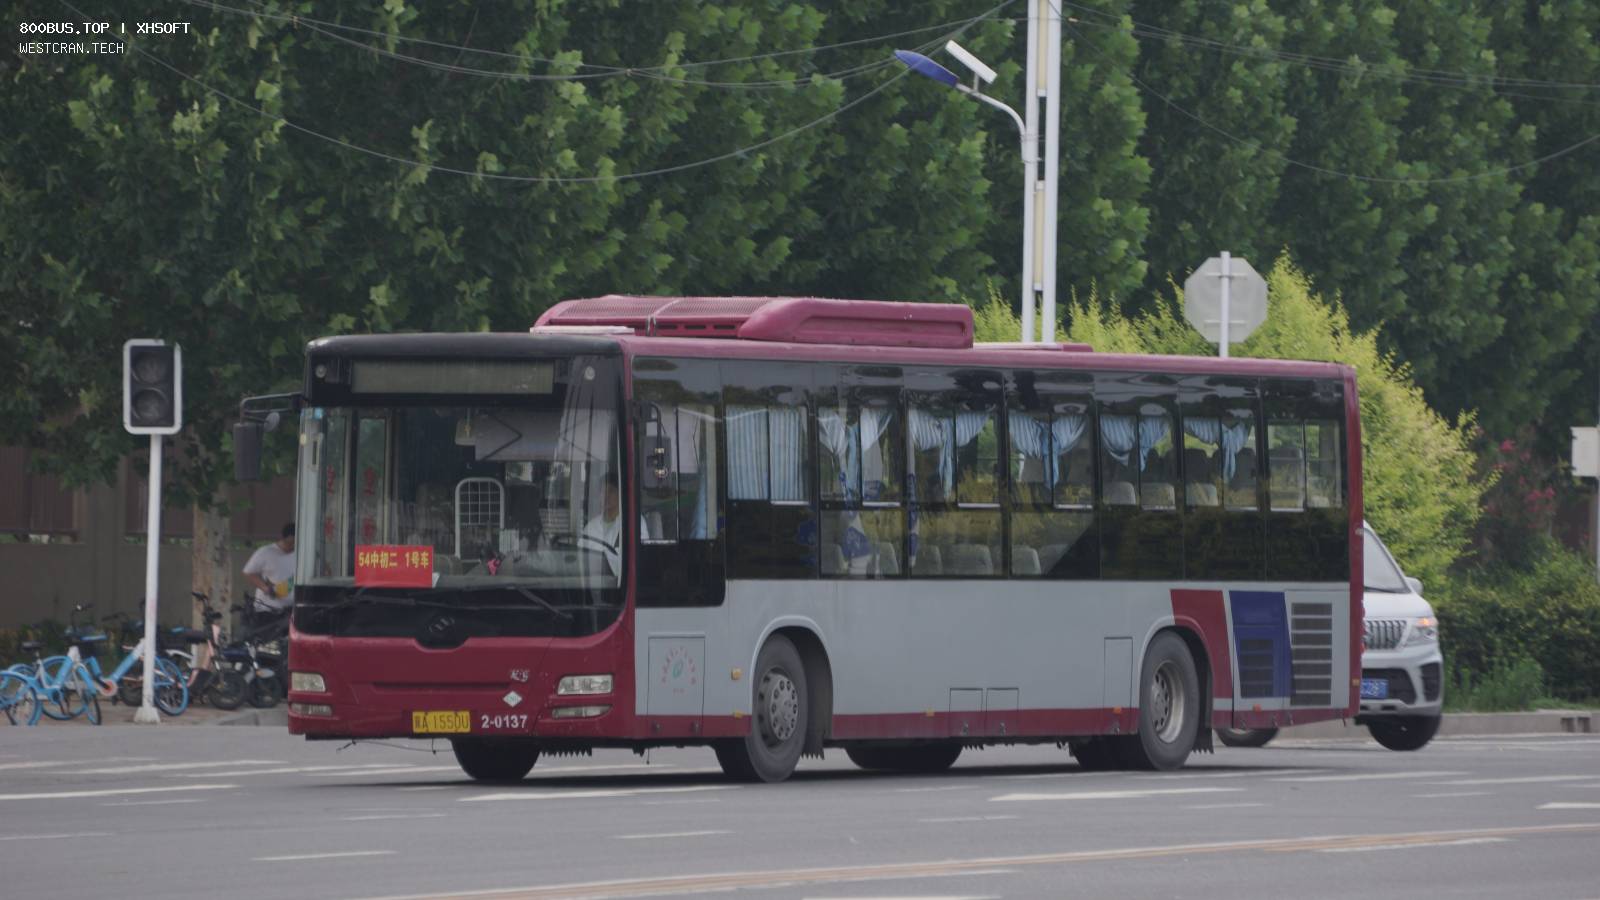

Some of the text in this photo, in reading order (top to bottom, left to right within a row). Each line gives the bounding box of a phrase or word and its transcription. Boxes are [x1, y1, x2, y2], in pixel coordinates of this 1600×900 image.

[358, 550, 429, 568] 54中初二 1号车
[481, 714, 528, 729] 2-0137
